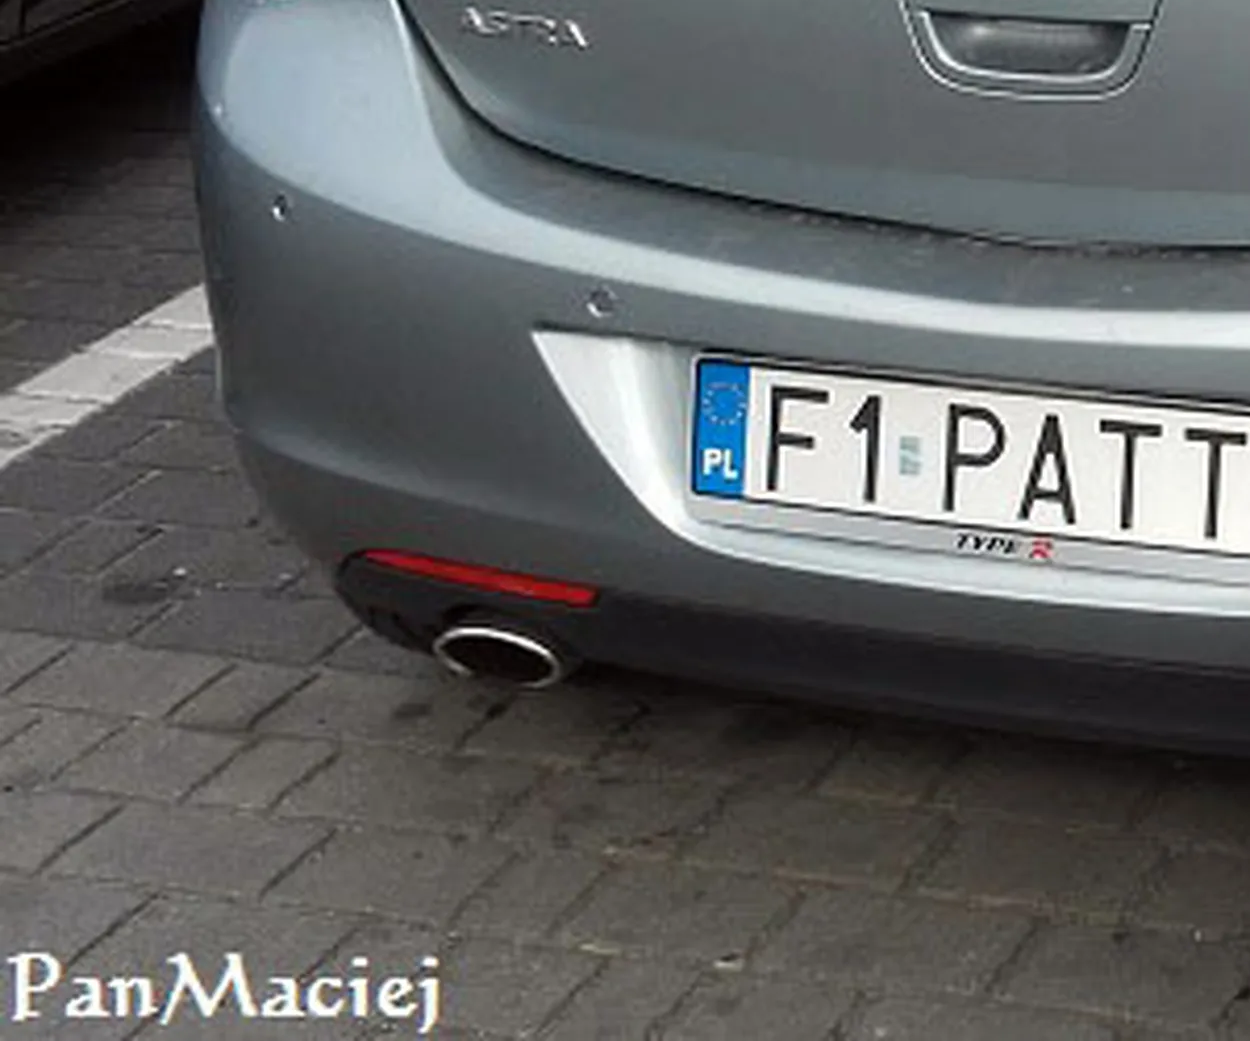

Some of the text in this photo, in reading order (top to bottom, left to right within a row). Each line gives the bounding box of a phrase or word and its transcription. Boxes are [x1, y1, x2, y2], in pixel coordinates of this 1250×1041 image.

[765, 384, 886, 504] F1
[703, 447, 738, 480] PL
[957, 531, 1021, 556] TYPE
